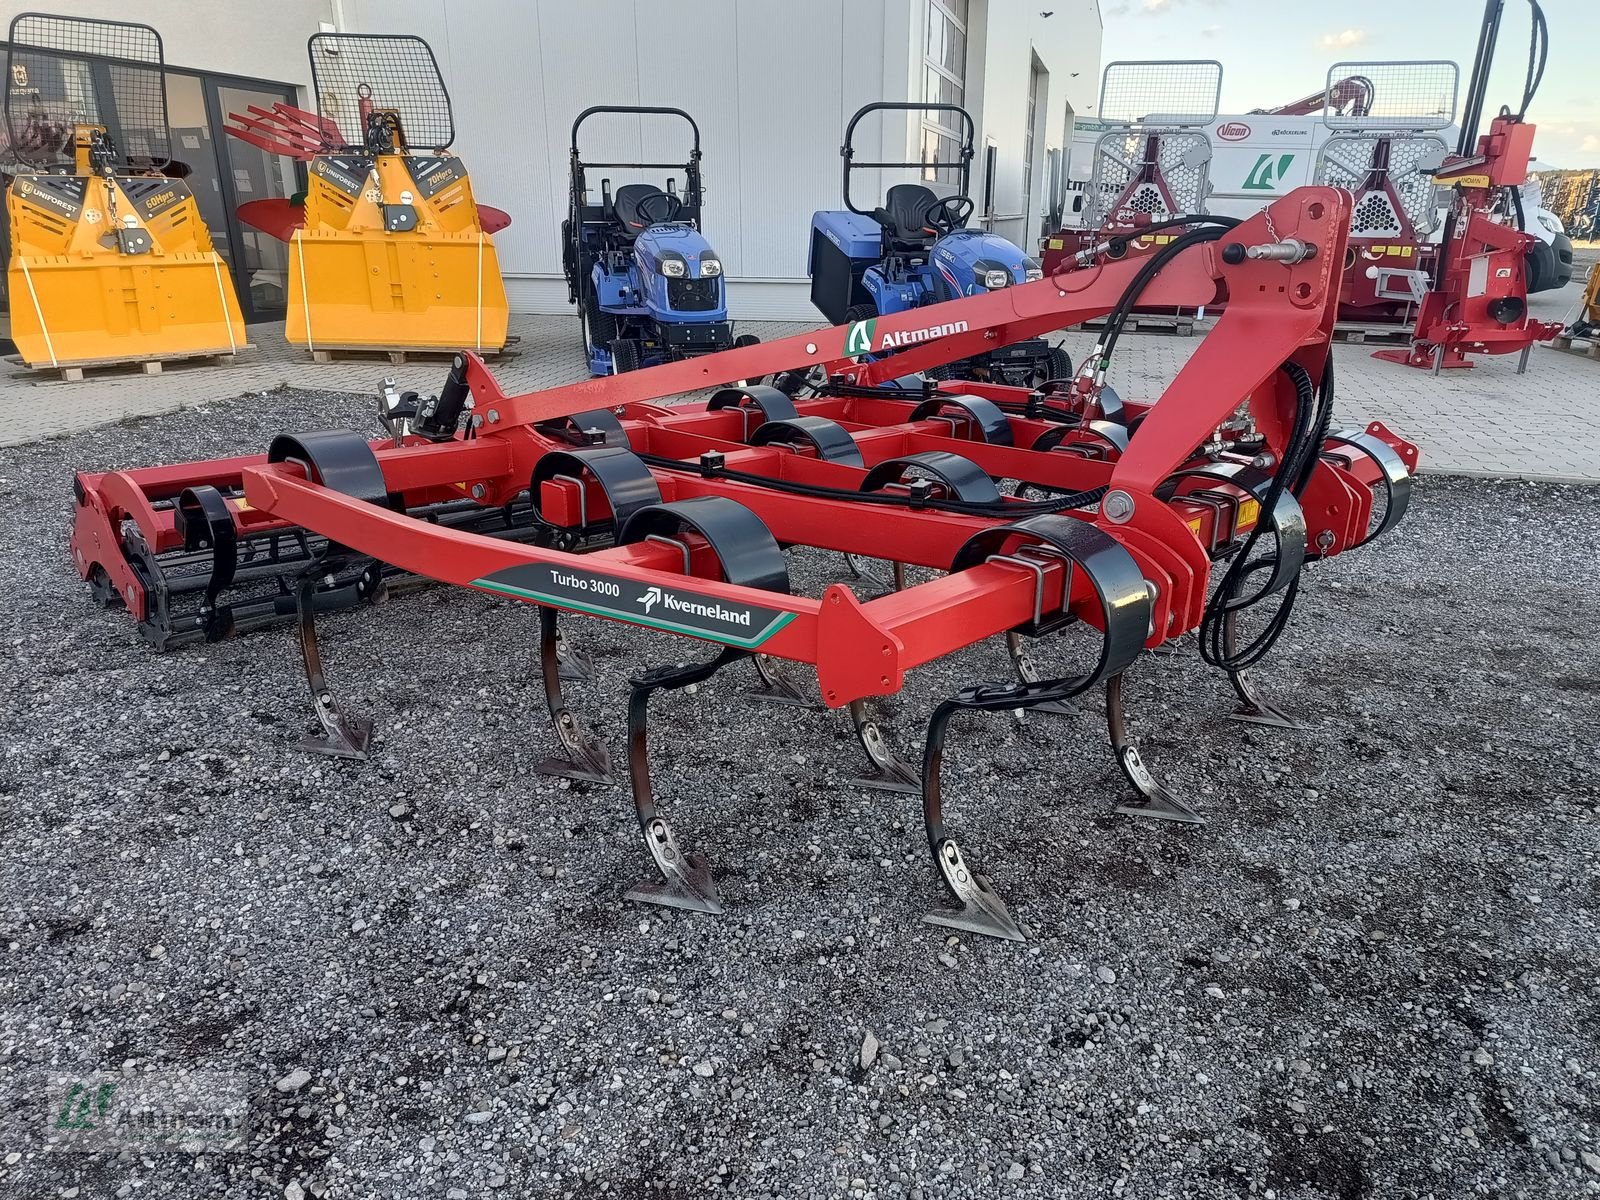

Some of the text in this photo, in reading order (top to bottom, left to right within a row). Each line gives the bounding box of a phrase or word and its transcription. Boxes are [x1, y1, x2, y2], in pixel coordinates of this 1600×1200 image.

[1221, 123, 1247, 136] Vicon
[326, 167, 360, 191] UNIFOREST
[427, 167, 453, 187] 70Hpro
[33, 188, 78, 213] UNIFOREST
[145, 190, 175, 209] 60Hpro
[940, 248, 957, 264] ISEKI
[881, 320, 969, 349] Altmann
[550, 570, 620, 597] Turbo 3000
[664, 593, 750, 626] Kverneland
